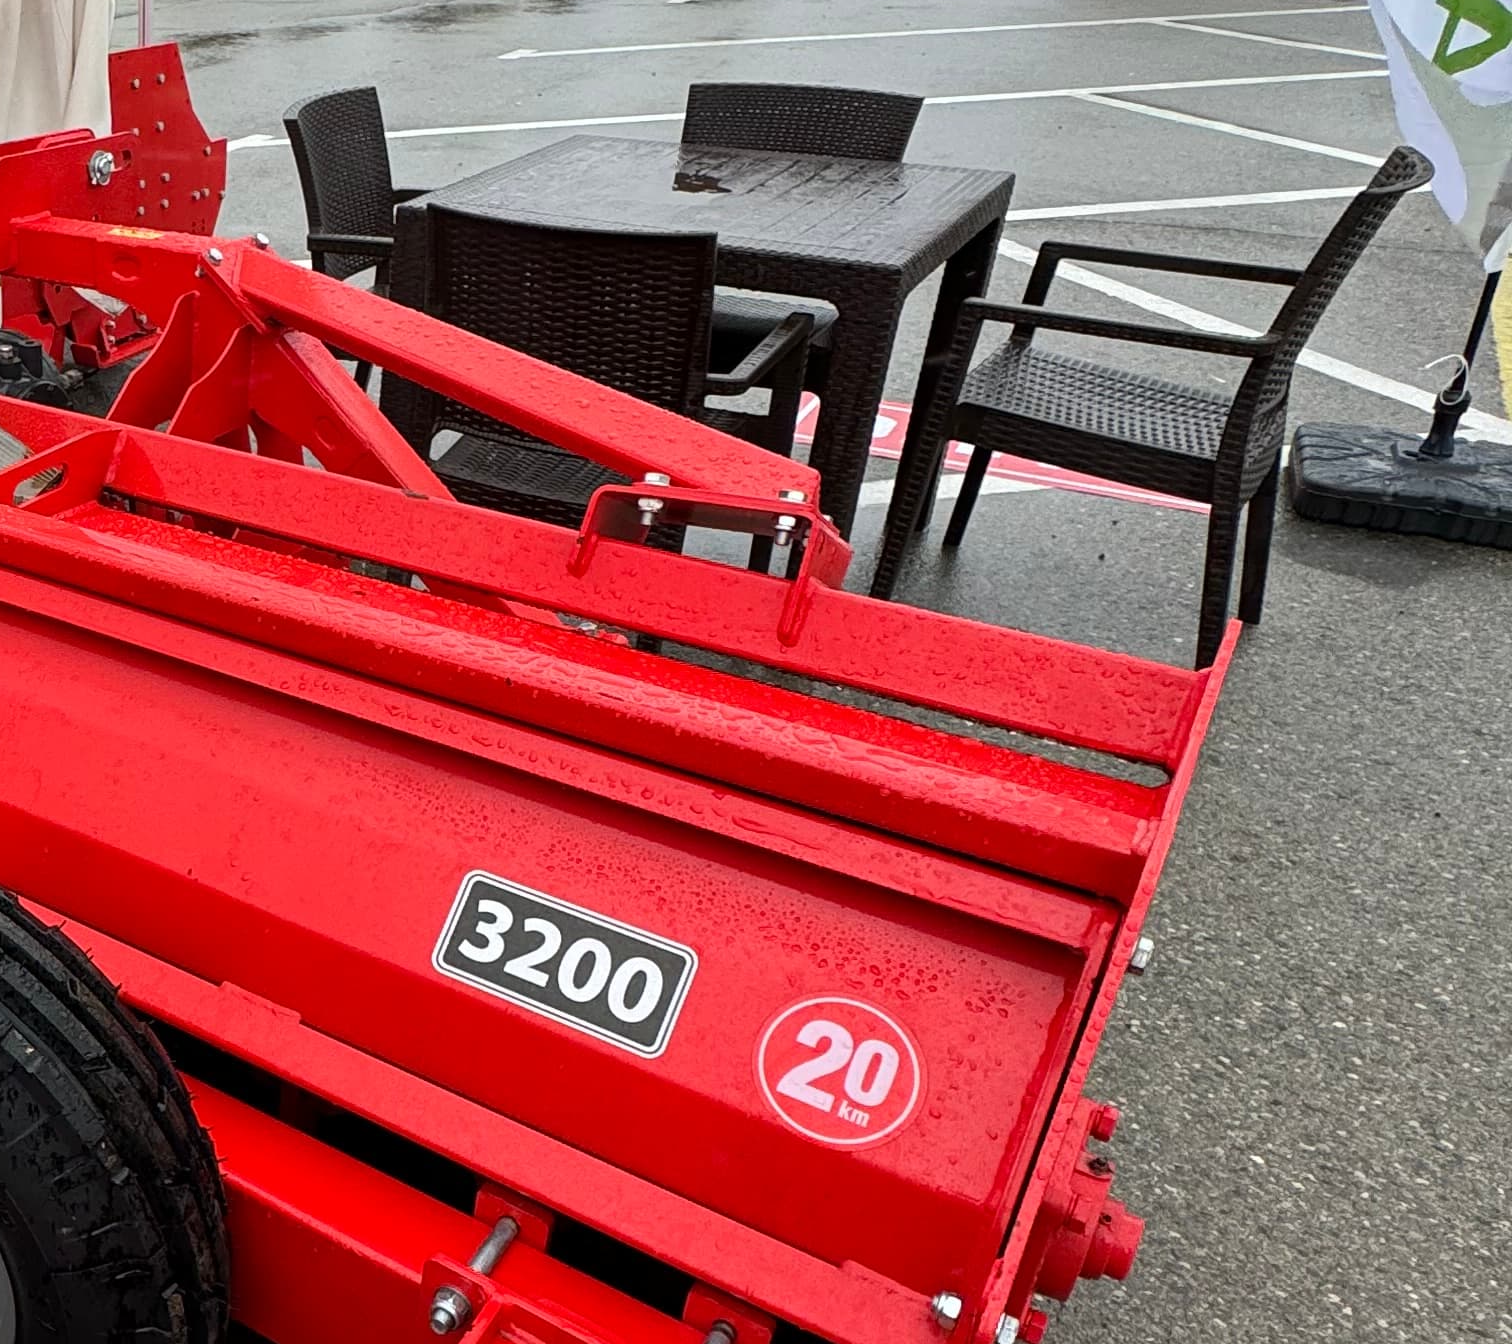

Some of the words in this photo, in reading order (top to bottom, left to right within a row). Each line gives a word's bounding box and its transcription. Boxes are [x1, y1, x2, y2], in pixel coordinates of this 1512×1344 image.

[457, 899, 664, 1024] 3200
[775, 1019, 900, 1113] 20
[838, 1100, 871, 1128] km
